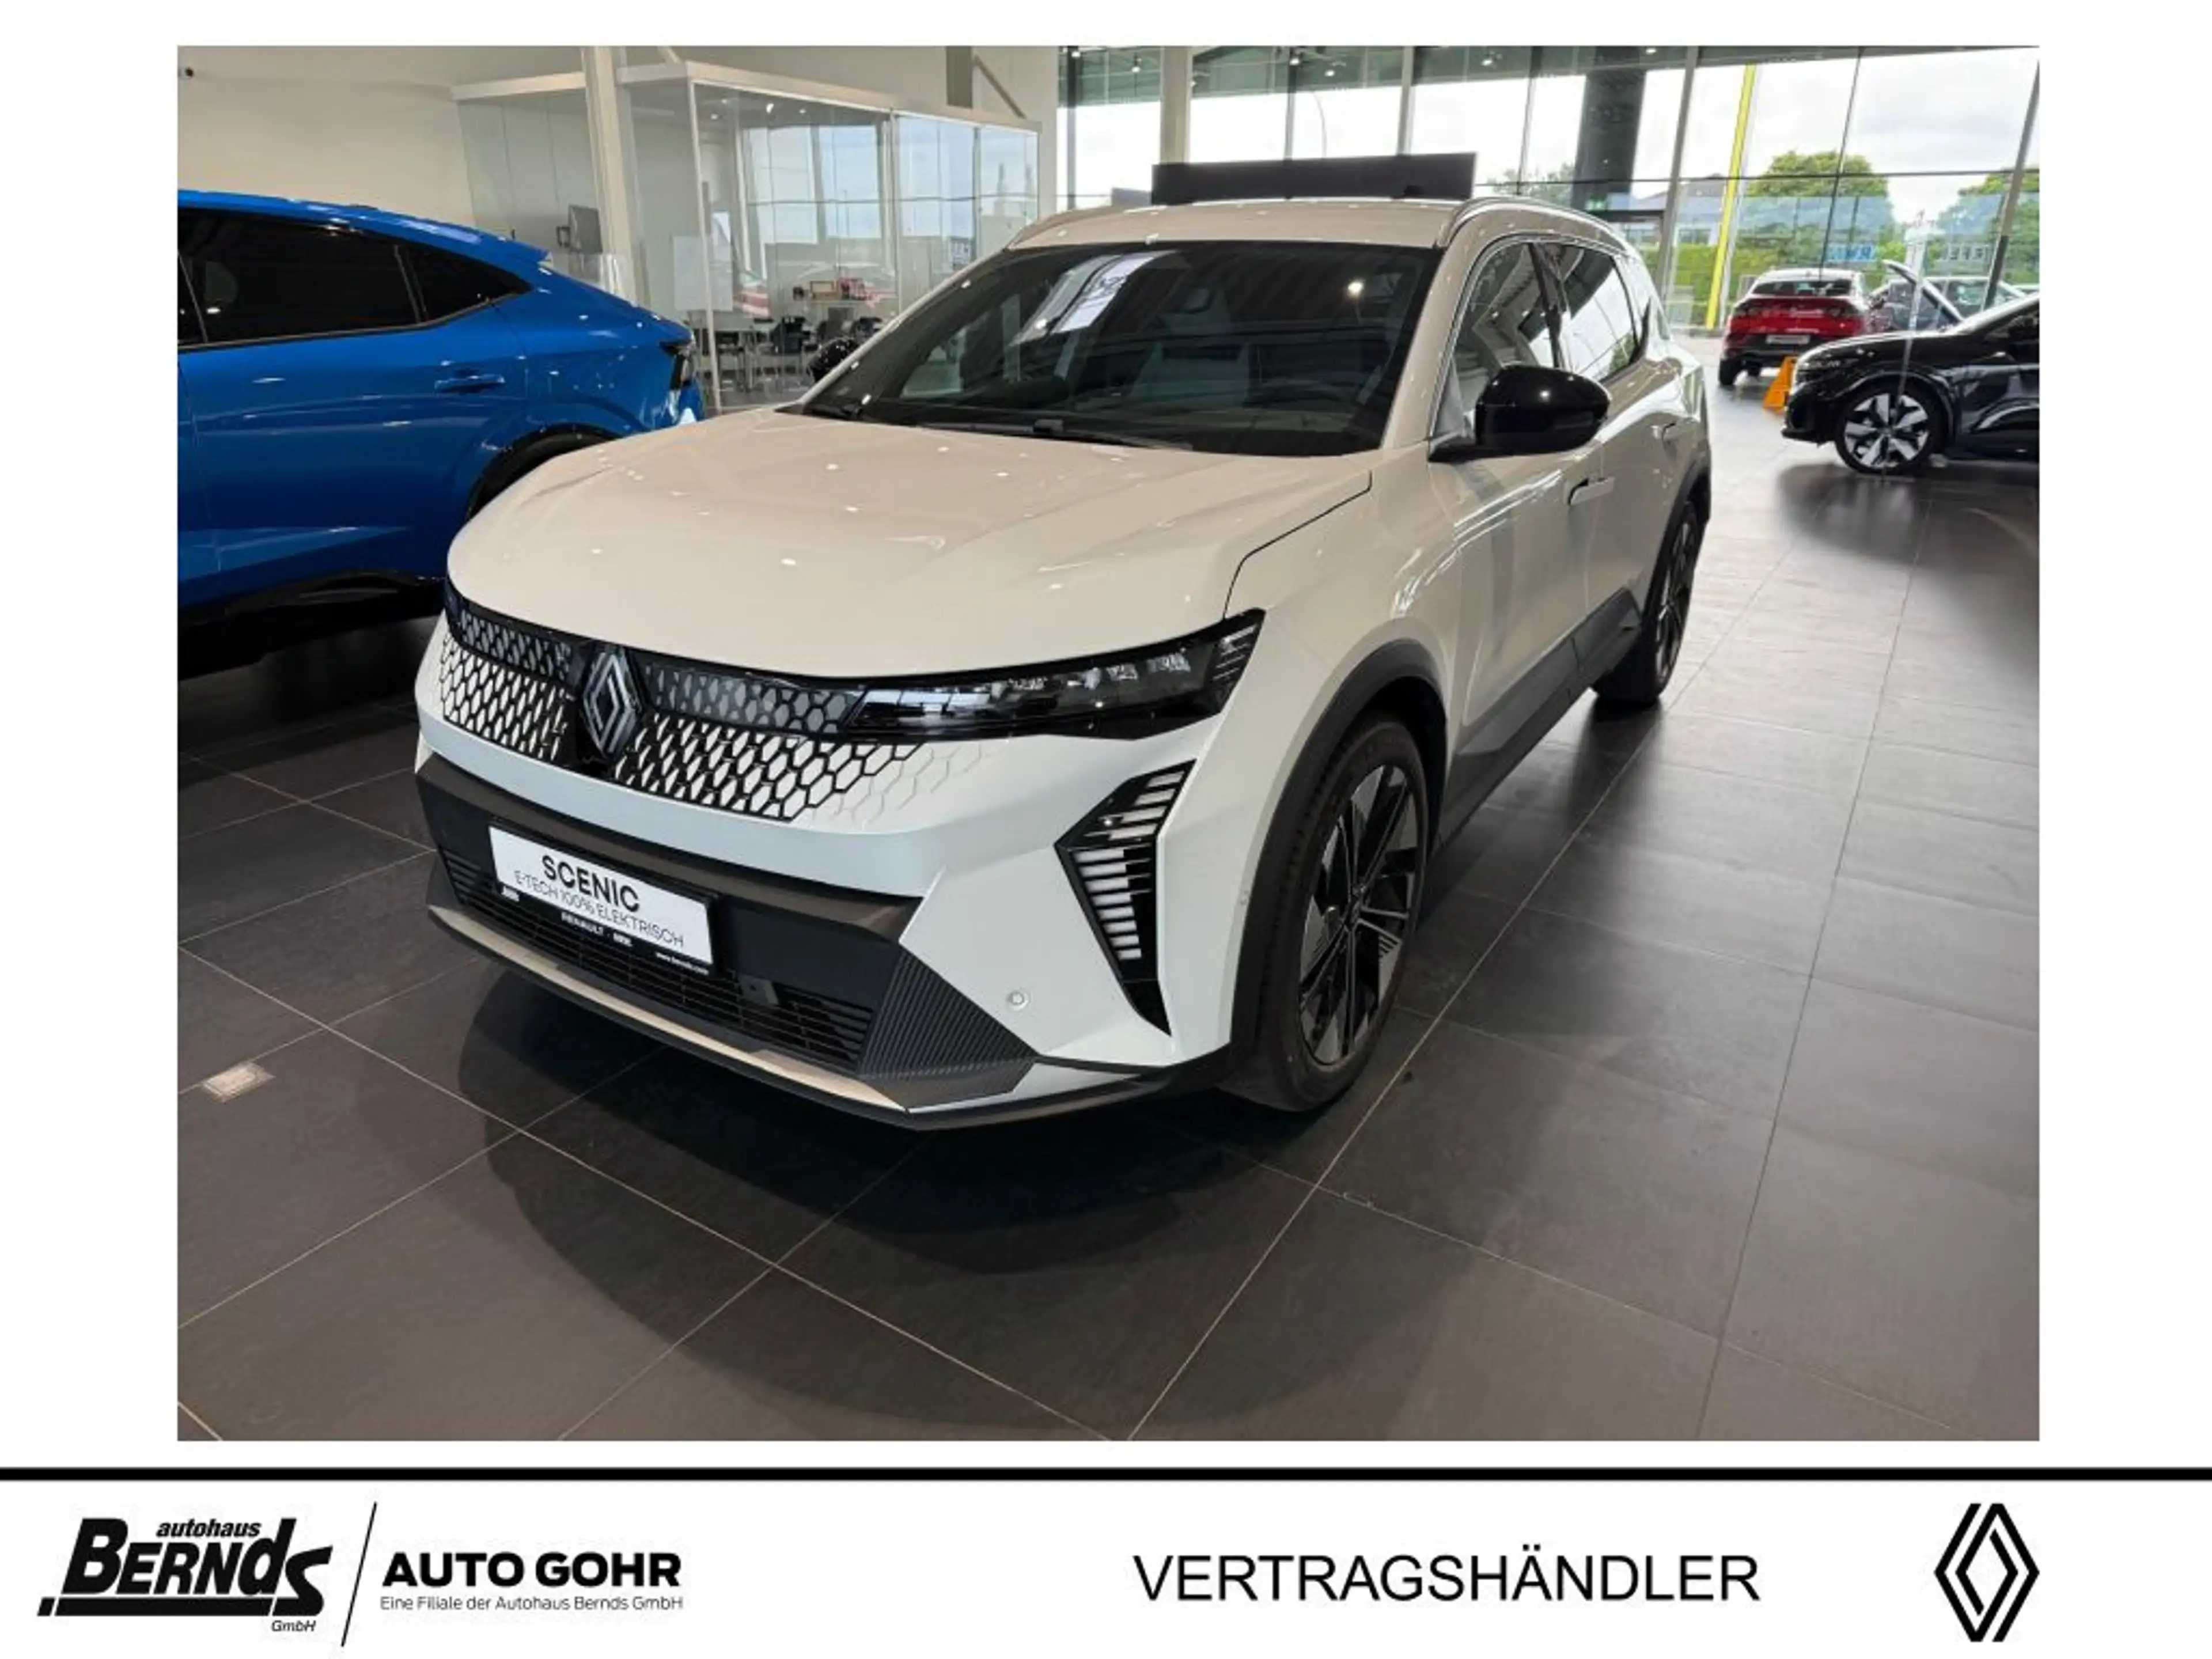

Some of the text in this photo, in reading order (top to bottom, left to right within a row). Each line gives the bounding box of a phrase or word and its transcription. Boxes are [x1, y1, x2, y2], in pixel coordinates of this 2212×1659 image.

[514, 870, 559, 899] E-TECH
[561, 891, 595, 915] 100%
[597, 903, 684, 947] ELEKTRISCH
[541, 855, 640, 912] SCENIC
